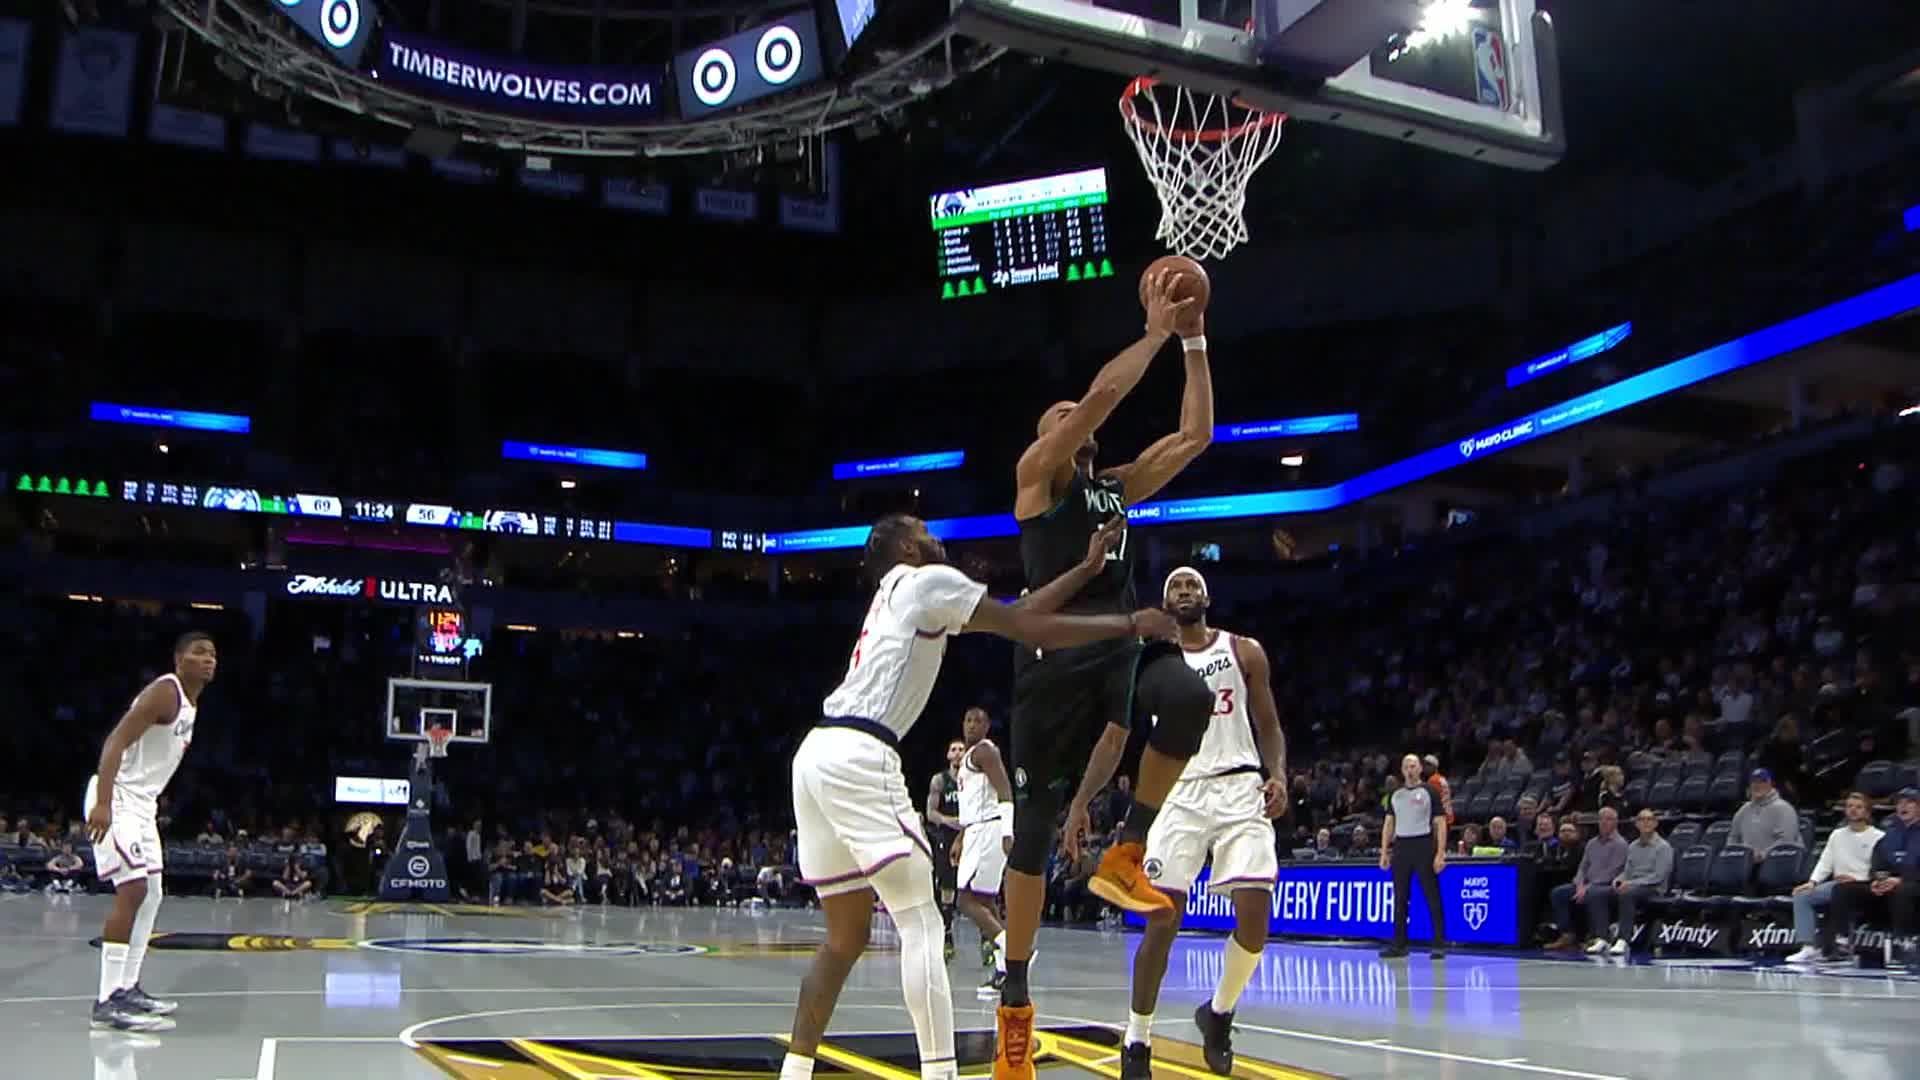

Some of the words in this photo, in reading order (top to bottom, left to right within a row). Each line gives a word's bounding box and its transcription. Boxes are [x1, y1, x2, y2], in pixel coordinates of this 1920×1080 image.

[389, 42, 652, 106] TIMBERWOLVES.COM
[1475, 432, 1501, 450] MAYO
[1501, 421, 1533, 443] CLINIC
[313, 499, 331, 513] 69
[355, 502, 394, 519] 11:24
[380, 581, 453, 603] ULTRA
[390, 879, 446, 889] CFMOTO
[1464, 877, 1488, 888] MAYO
[1186, 881, 1236, 917] CHAN
[1272, 881, 1322, 921] VERY
[1326, 881, 1411, 924] FUTUR
[1461, 888, 1490, 899] CLINIC
[1658, 920, 1719, 948] xfinity
